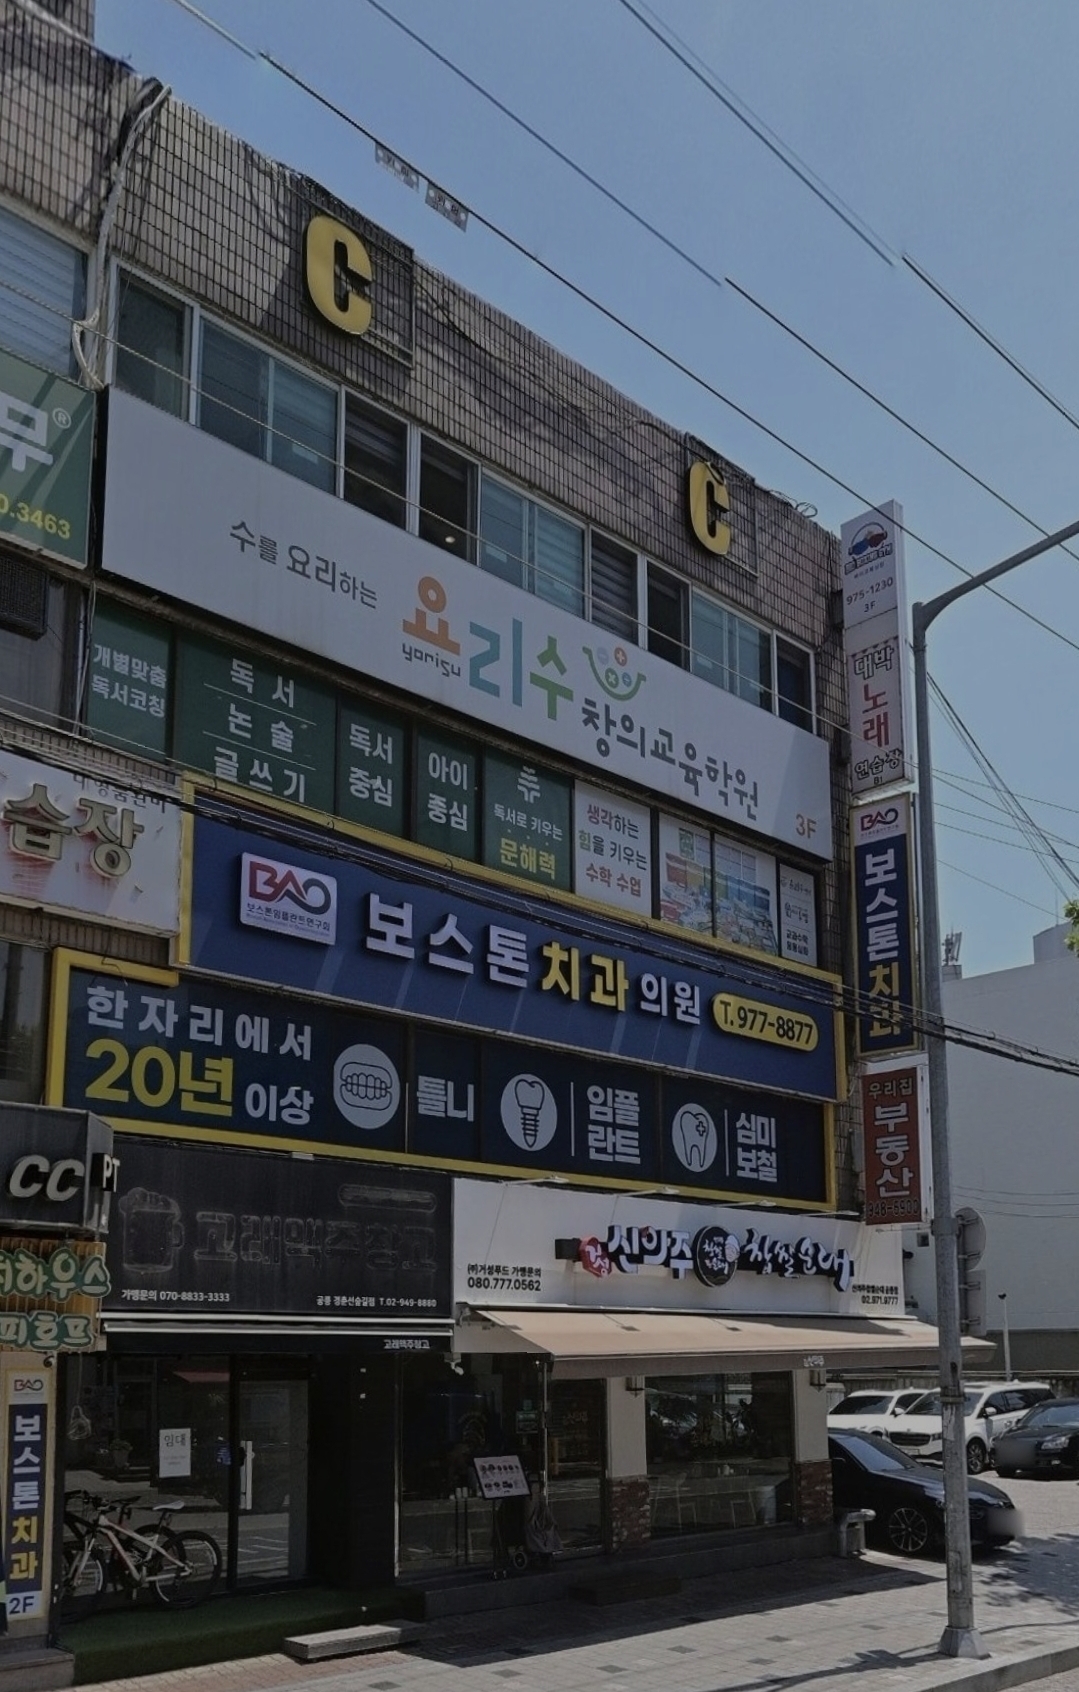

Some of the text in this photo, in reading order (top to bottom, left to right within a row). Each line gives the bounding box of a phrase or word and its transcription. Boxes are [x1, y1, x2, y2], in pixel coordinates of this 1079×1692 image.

[304, 214, 373, 335] C
[688, 461, 731, 555] C
[230, 521, 377, 609] 수를 요리하는
[846, 577, 893, 605] 975-1230
[864, 600, 876, 613] 3F
[92, 643, 167, 689] 개별맞춤
[402, 576, 574, 721] 요리수
[854, 645, 895, 680] 대박
[91, 674, 165, 718] 독서코칭
[349, 723, 393, 765] 독서
[582, 698, 757, 821] 창의교육학원
[349, 766, 393, 808] 중심
[428, 751, 468, 791] 아이
[428, 792, 468, 832] 중심
[494, 803, 563, 841] 독서로 키우는
[587, 804, 639, 840] 생각하는
[795, 813, 818, 839] 3F
[500, 837, 555, 880] 문해력
[578, 830, 605, 856] 힘을
[610, 841, 648, 871] 키우는
[249, 861, 331, 915] BAO
[586, 863, 642, 898] 수학 수업
[85, 1038, 314, 1126] 20년 이상
[417, 1075, 475, 1122] 틀니
[868, 1078, 914, 1099] 우리집
[586, 1084, 640, 1127] 임플
[587, 1124, 640, 1165] 란트
[736, 1112, 776, 1149] 심미
[873, 1102, 914, 1198] 부동산
[102, 1153, 120, 1192] PT
[737, 1146, 778, 1183] 보철
[121, 1289, 157, 1302] 가맹문의
[467, 1276, 541, 1292] 080.777.0562
[9, 1414, 41, 1581] 보스톤치과
[9, 1595, 35, 1615] 2F
